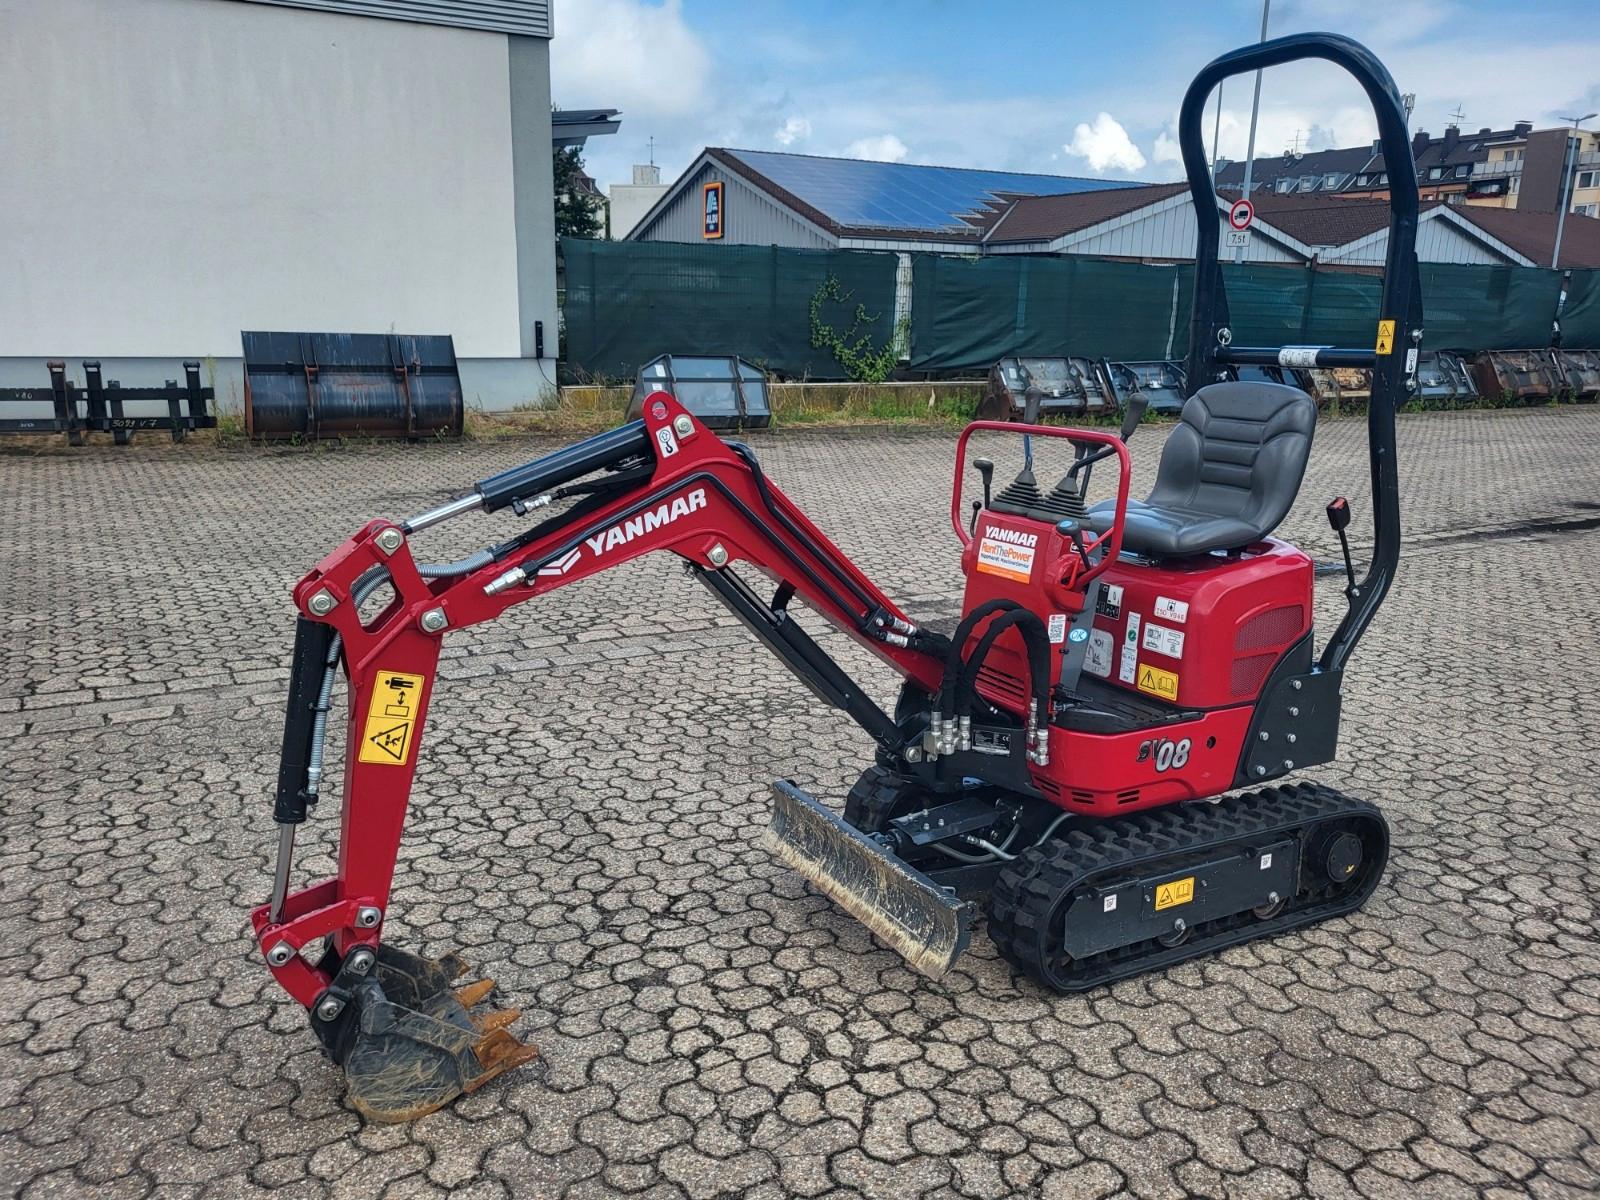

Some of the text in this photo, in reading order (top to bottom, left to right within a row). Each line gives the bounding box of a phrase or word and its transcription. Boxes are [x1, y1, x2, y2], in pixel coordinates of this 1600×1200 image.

[706, 213, 719, 224] ALDI
[585, 488, 707, 557] YANMAR
[985, 525, 1038, 548] YANMAR
[1136, 736, 1192, 774] SV08
